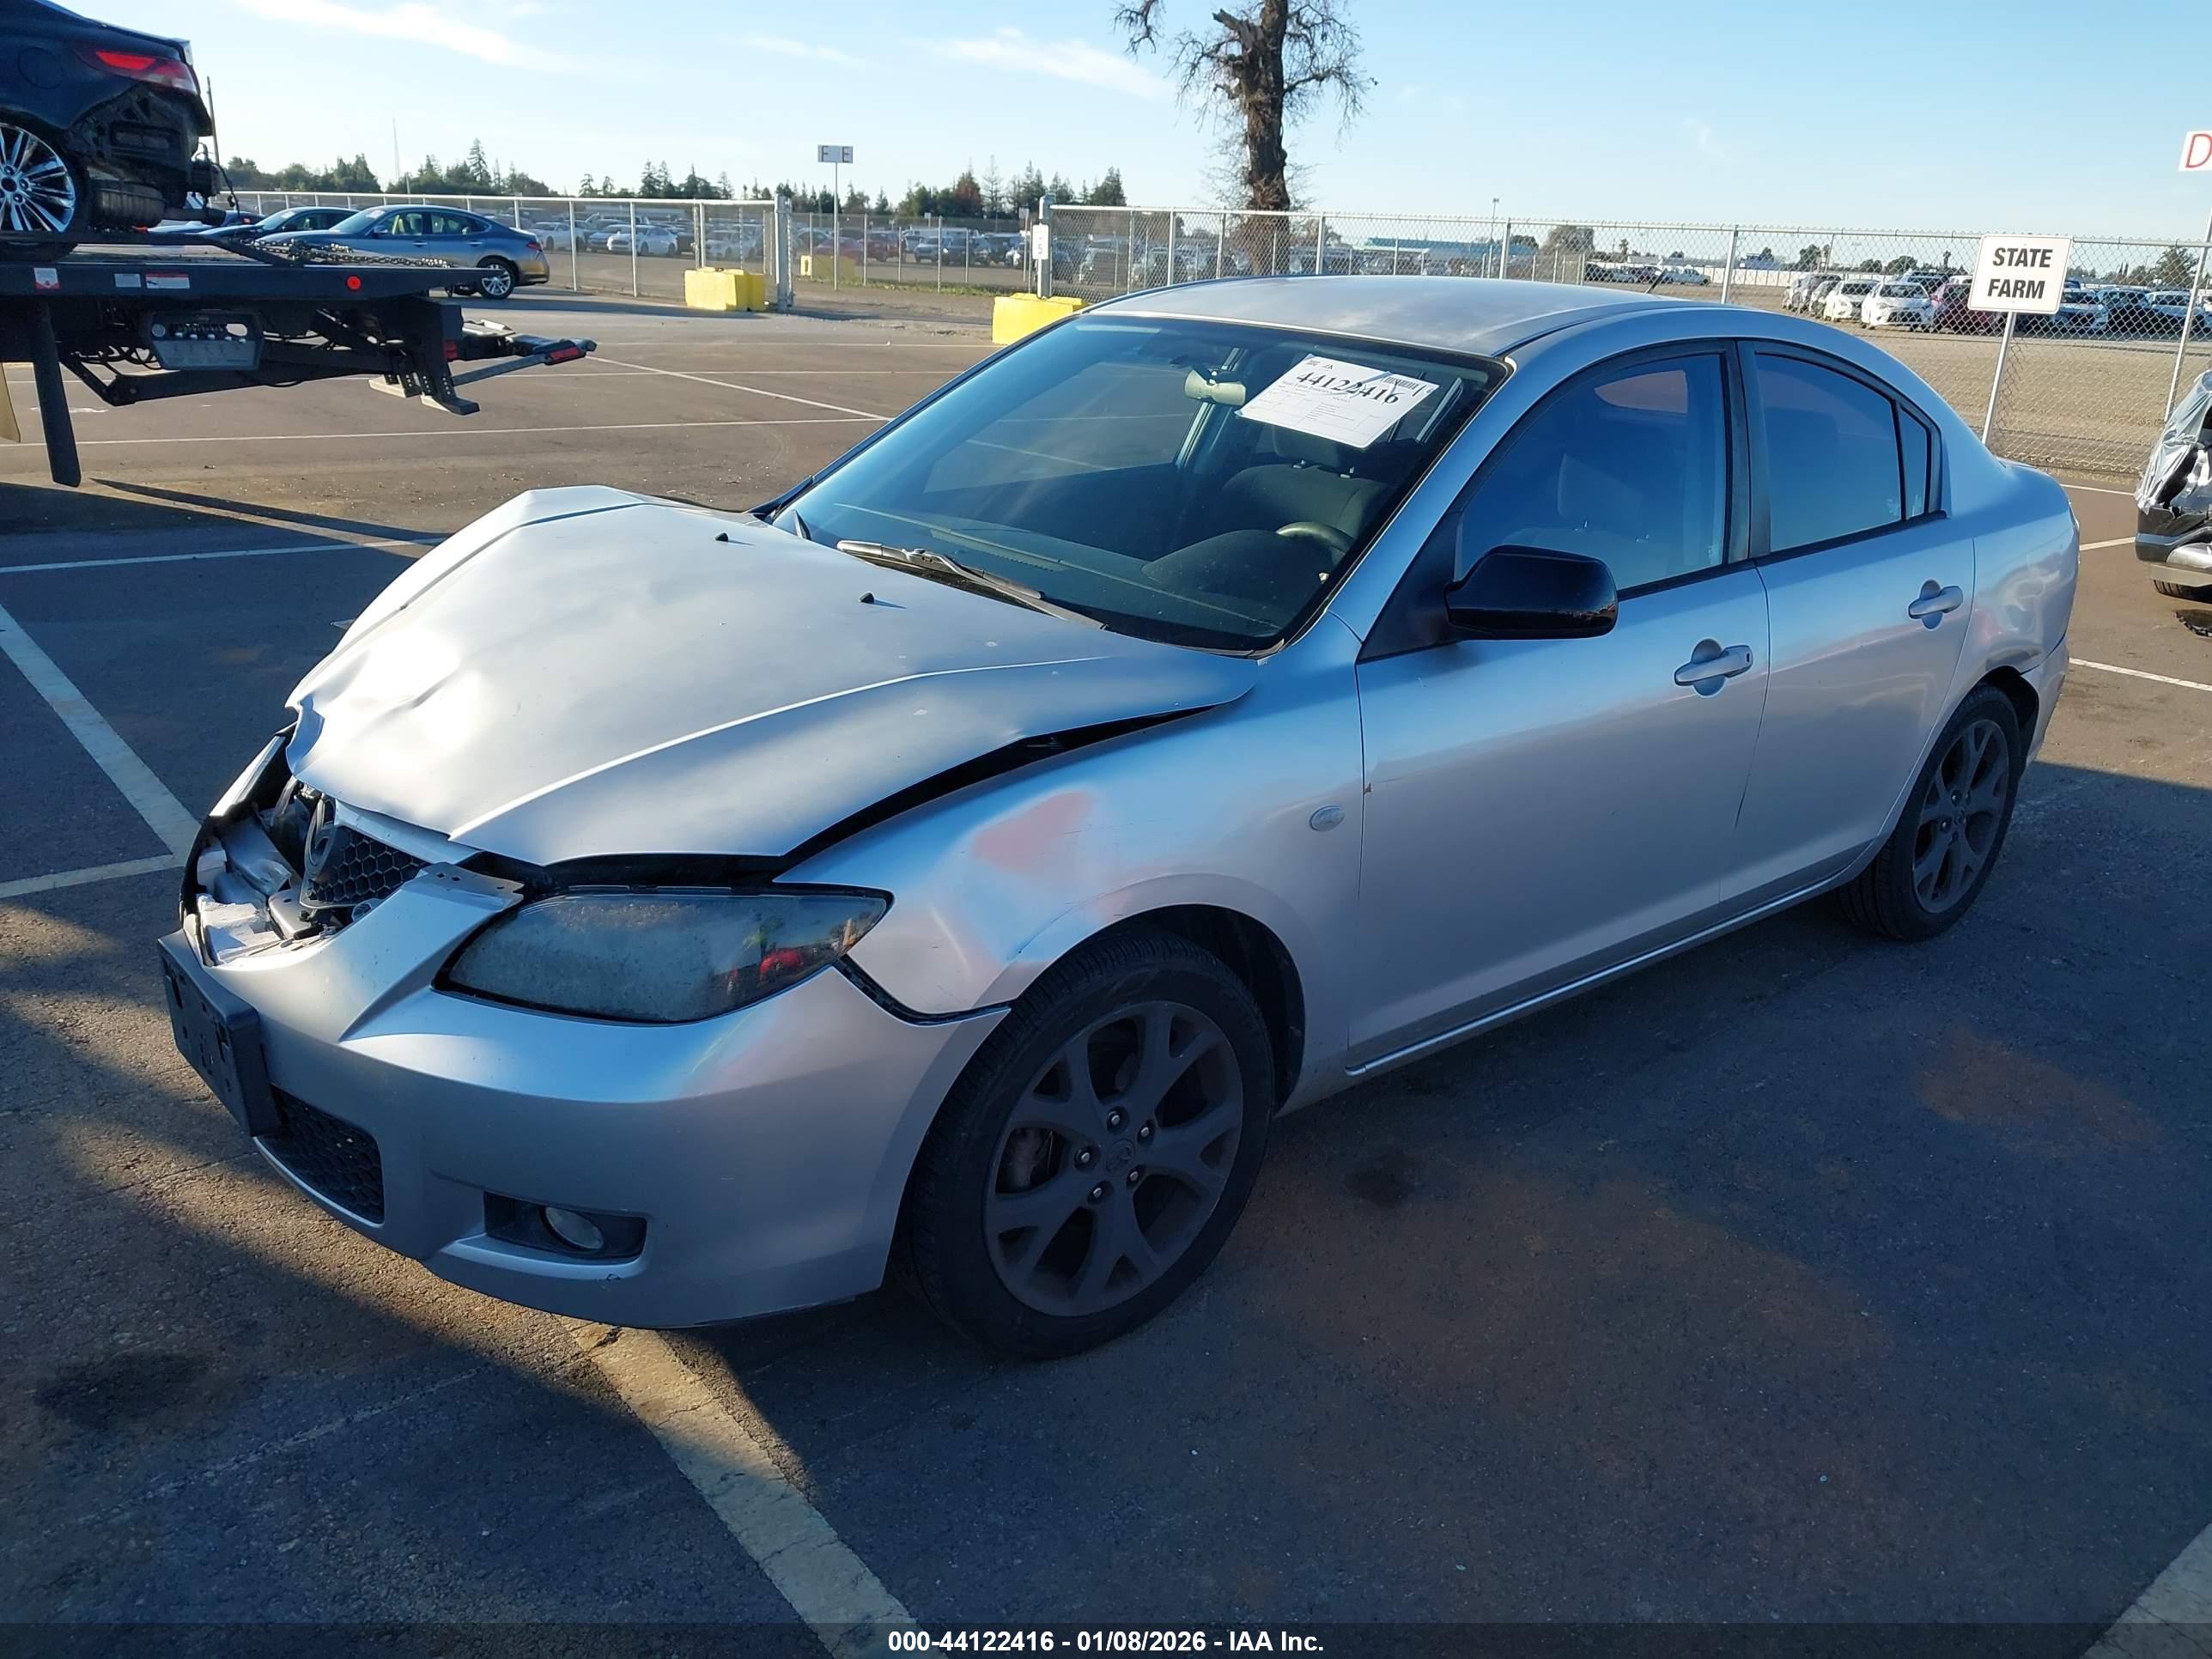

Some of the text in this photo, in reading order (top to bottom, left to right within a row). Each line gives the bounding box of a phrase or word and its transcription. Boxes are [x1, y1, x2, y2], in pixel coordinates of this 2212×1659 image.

[2185, 133, 2212, 168] D
[1992, 247, 2053, 268] STATE
[1987, 278, 2045, 300] FARM
[1297, 372, 1402, 404] 44122416
